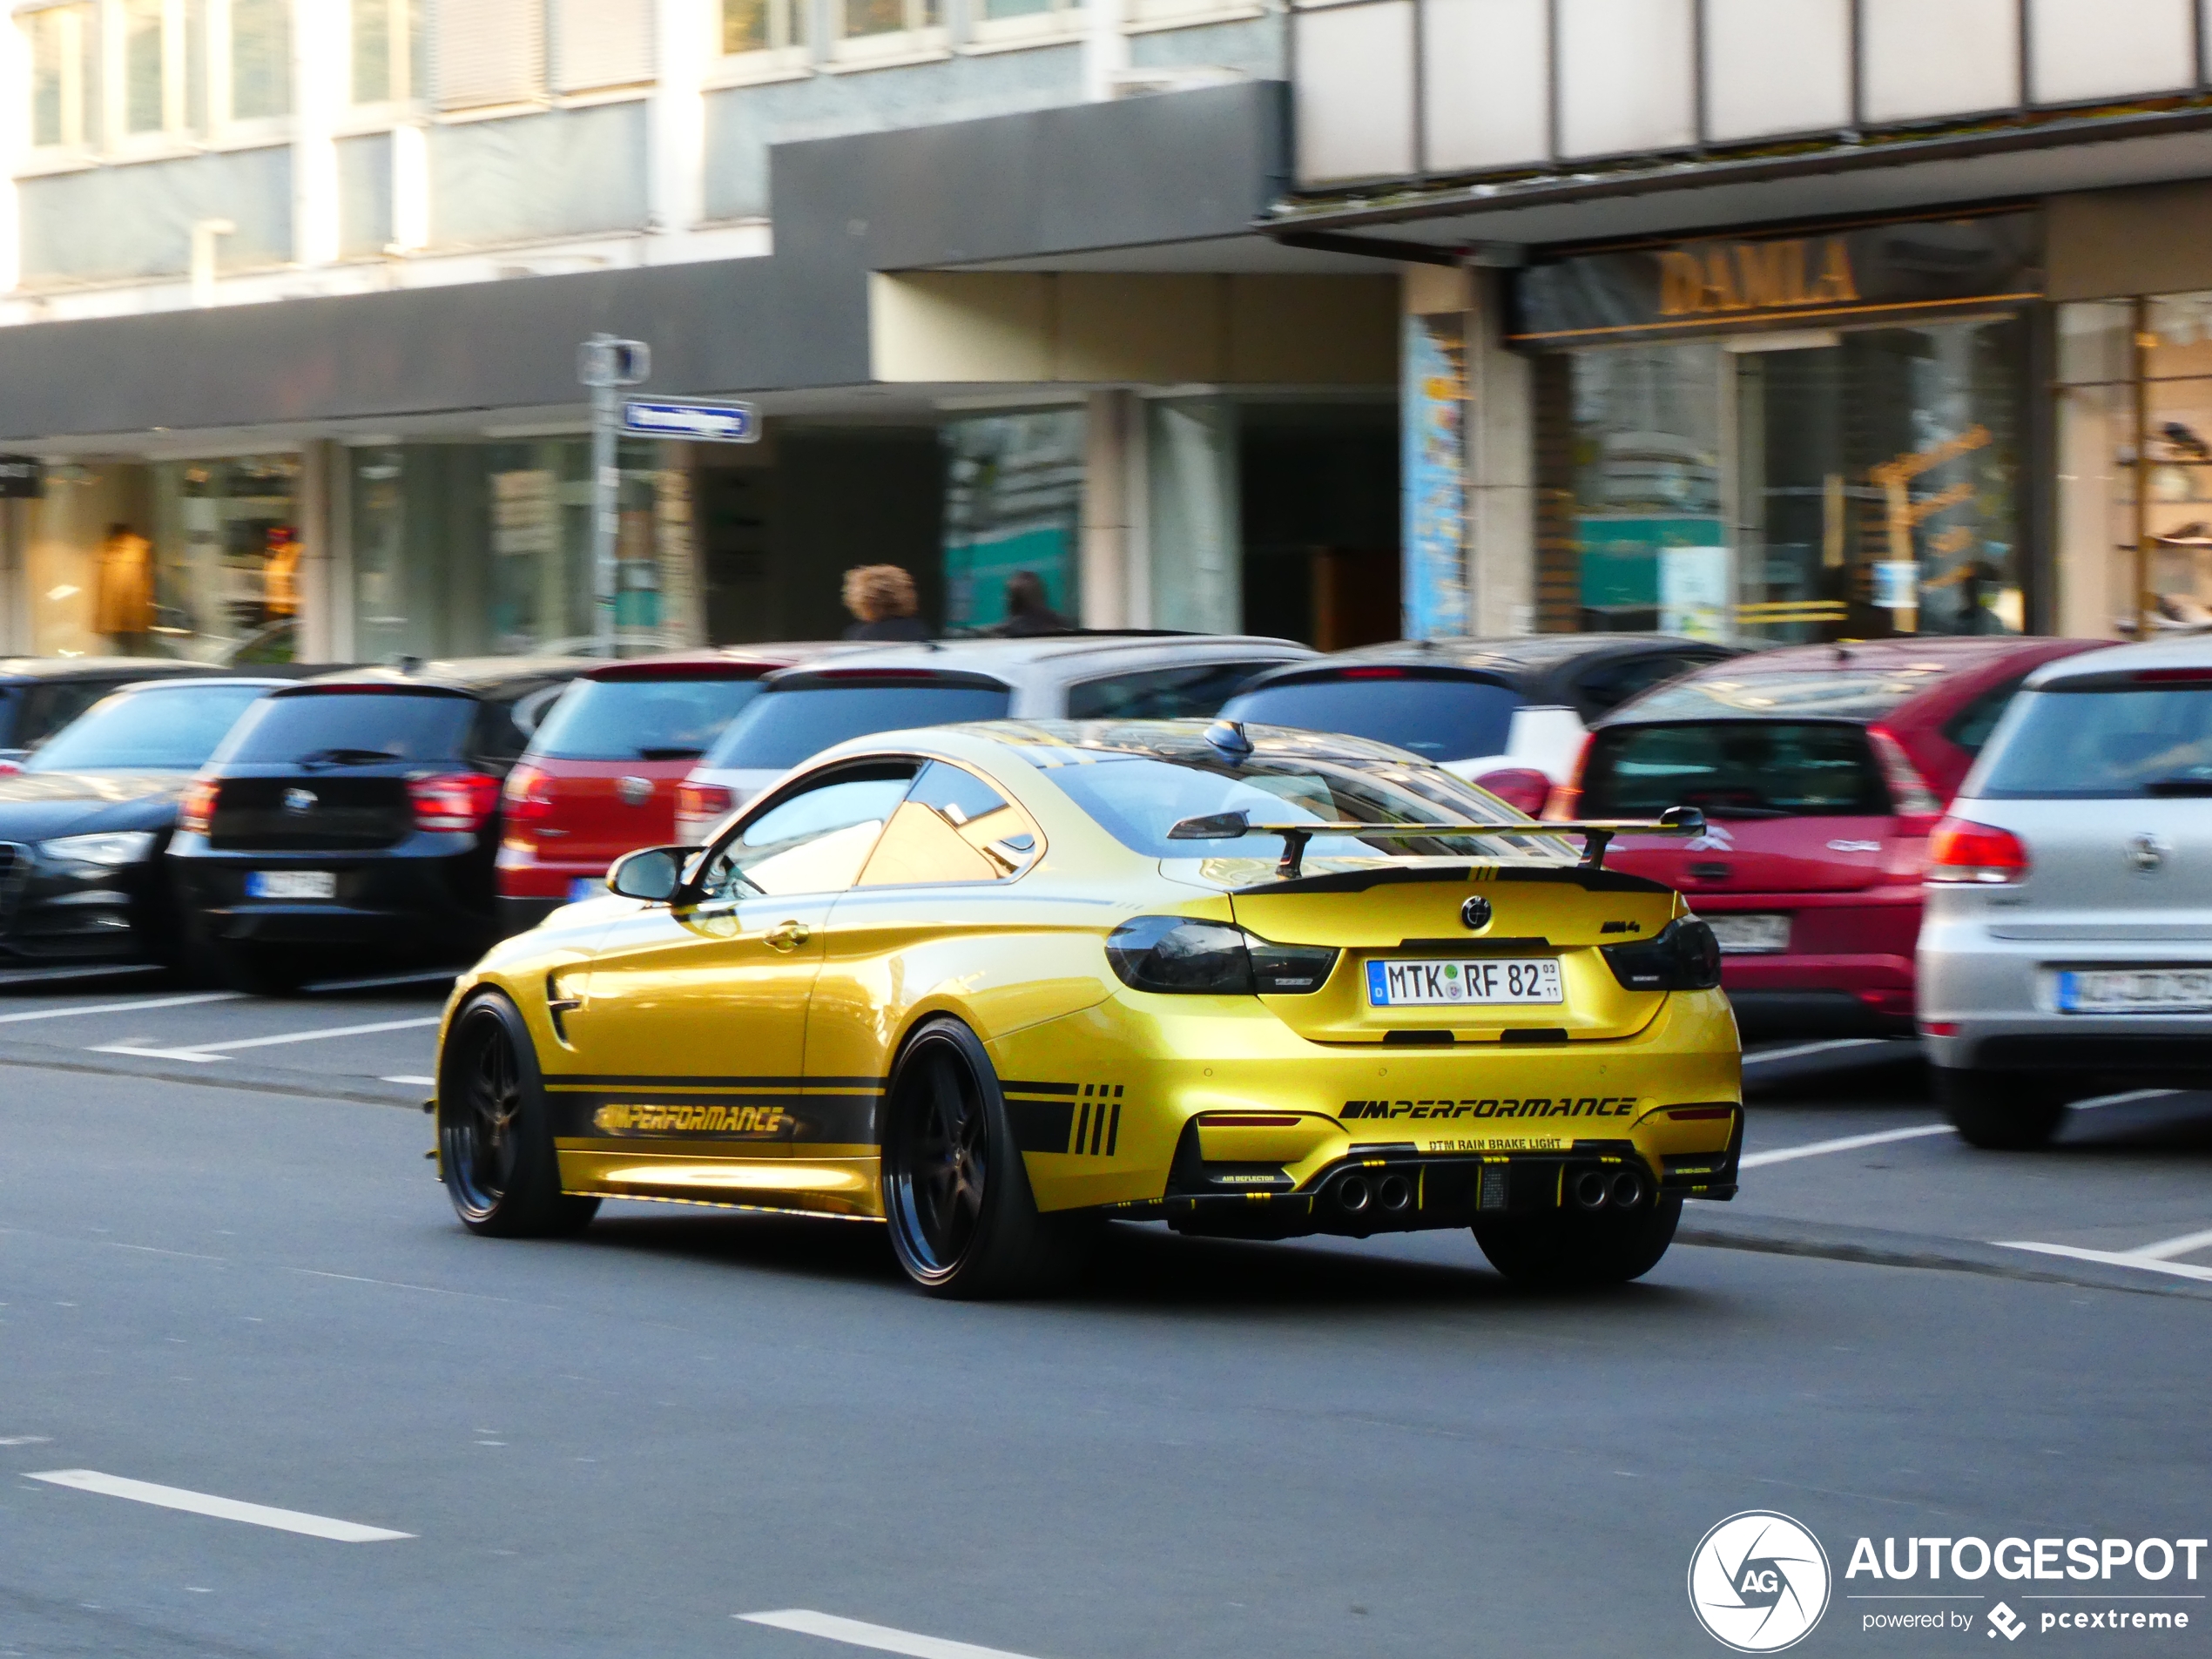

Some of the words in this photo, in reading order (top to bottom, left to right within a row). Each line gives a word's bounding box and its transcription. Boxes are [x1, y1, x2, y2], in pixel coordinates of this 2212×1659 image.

[1543, 964, 1556, 974] 03
[1387, 965, 1444, 998] MTK
[1464, 964, 1499, 997] RF
[1508, 964, 1541, 996] 82
[1374, 988, 1383, 998] D
[1428, 1140, 1455, 1151] DTM
[1458, 1139, 1486, 1150] RAIN
[1488, 1138, 1527, 1150] BRAKE
[1529, 1138, 1561, 1149] LIGHT
